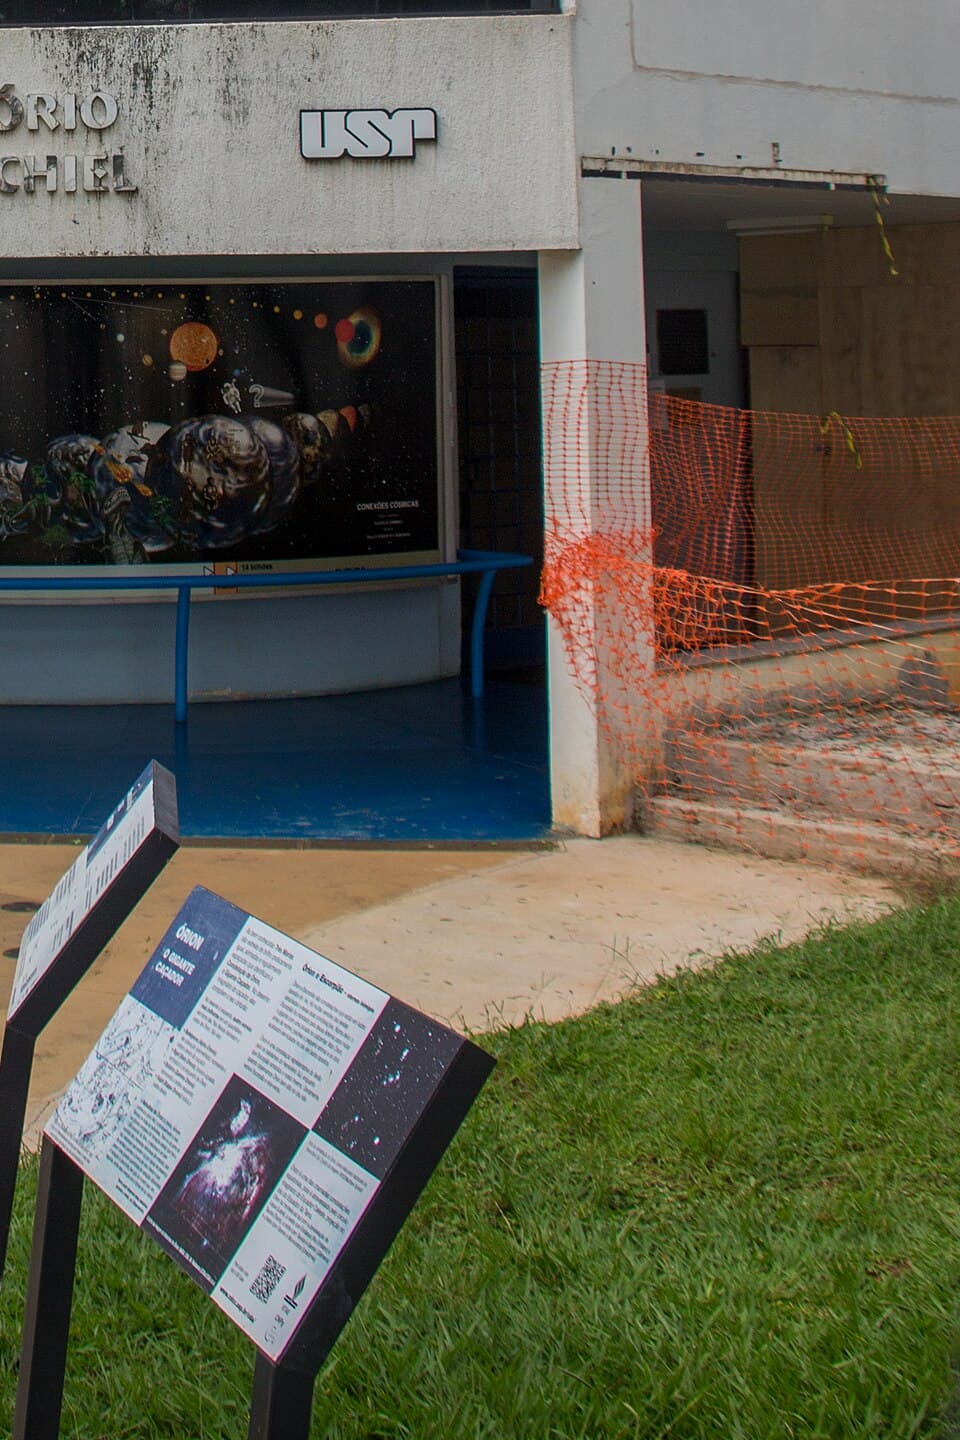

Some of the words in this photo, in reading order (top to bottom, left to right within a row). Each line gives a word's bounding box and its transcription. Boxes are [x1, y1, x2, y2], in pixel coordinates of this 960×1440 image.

[300, 108, 437, 159] USP
[176, 922, 204, 951] ÓRION
[155, 961, 184, 987] CAÇADOR
[163, 948, 171, 959] O
[168, 951, 195, 976] GIGANTE
